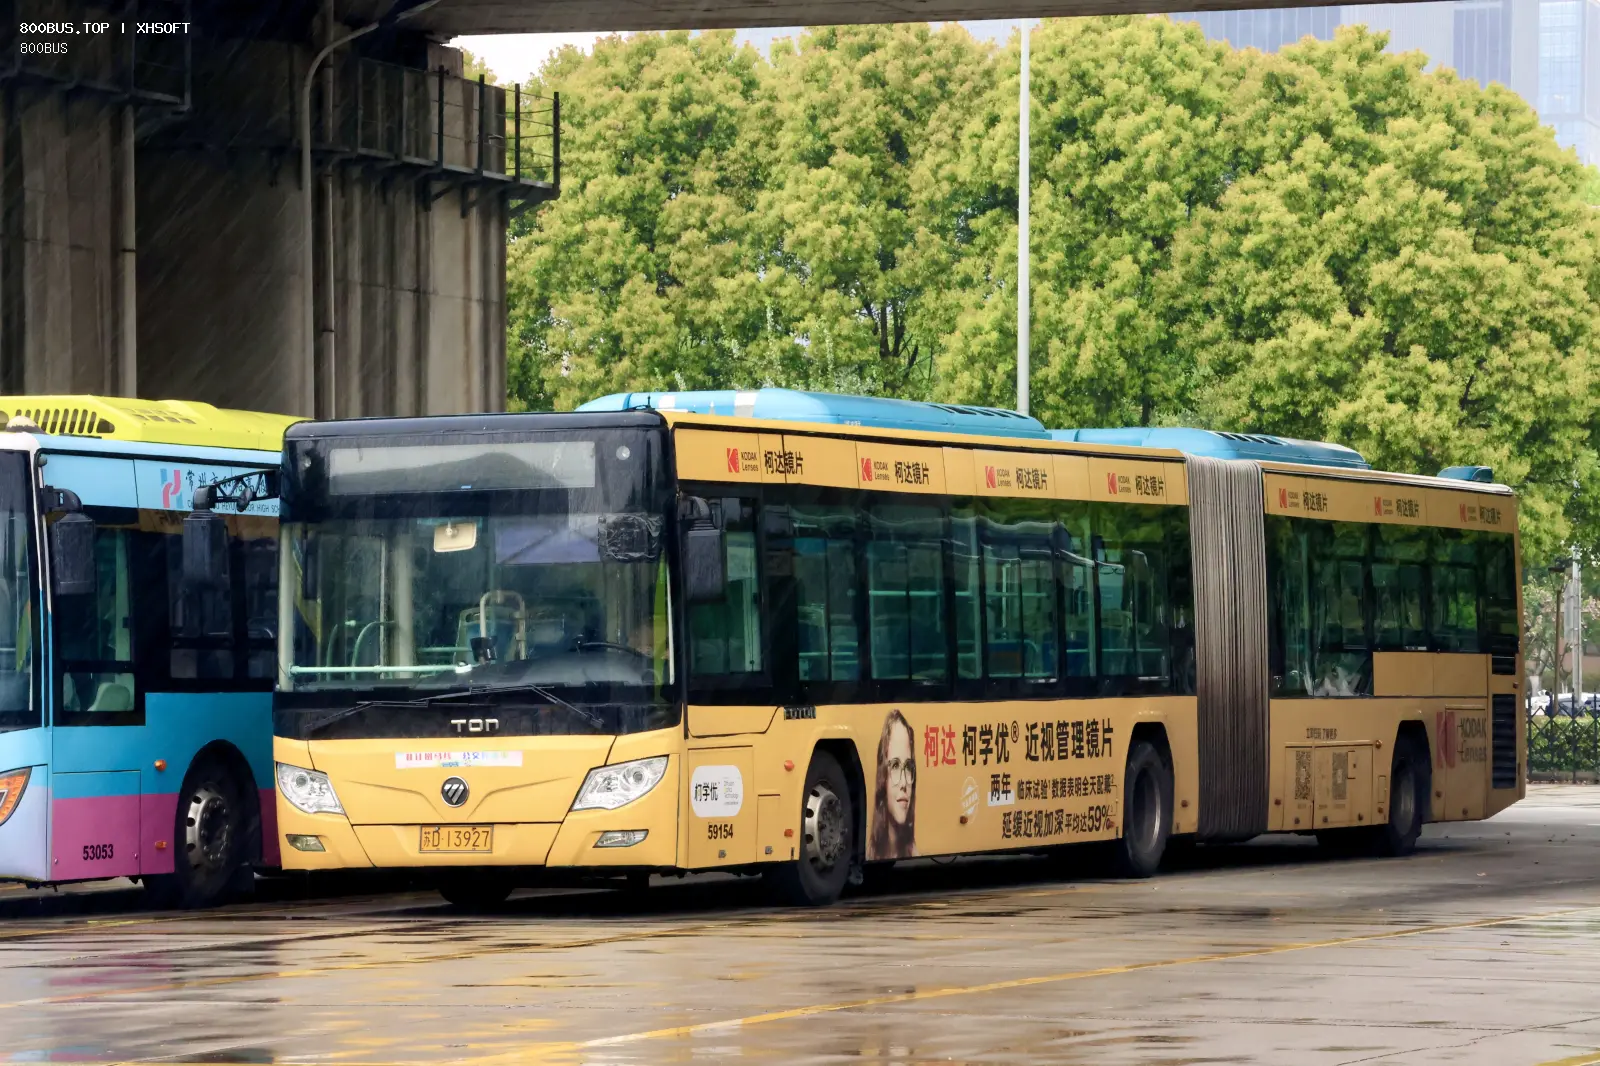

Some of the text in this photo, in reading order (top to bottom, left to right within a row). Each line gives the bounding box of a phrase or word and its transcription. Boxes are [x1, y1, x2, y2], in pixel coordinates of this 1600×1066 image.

[763, 449, 804, 475] 柯达镜片
[894, 460, 930, 485] 柯达镜片
[1015, 467, 1048, 490] 柯达镜片
[924, 724, 957, 767] 柯达
[1024, 718, 1114, 762] 近视管理镜片
[694, 782, 719, 802] 柯学优
[990, 773, 1012, 802] 两年
[708, 823, 734, 840] 59154
[83, 843, 114, 861] 53053
